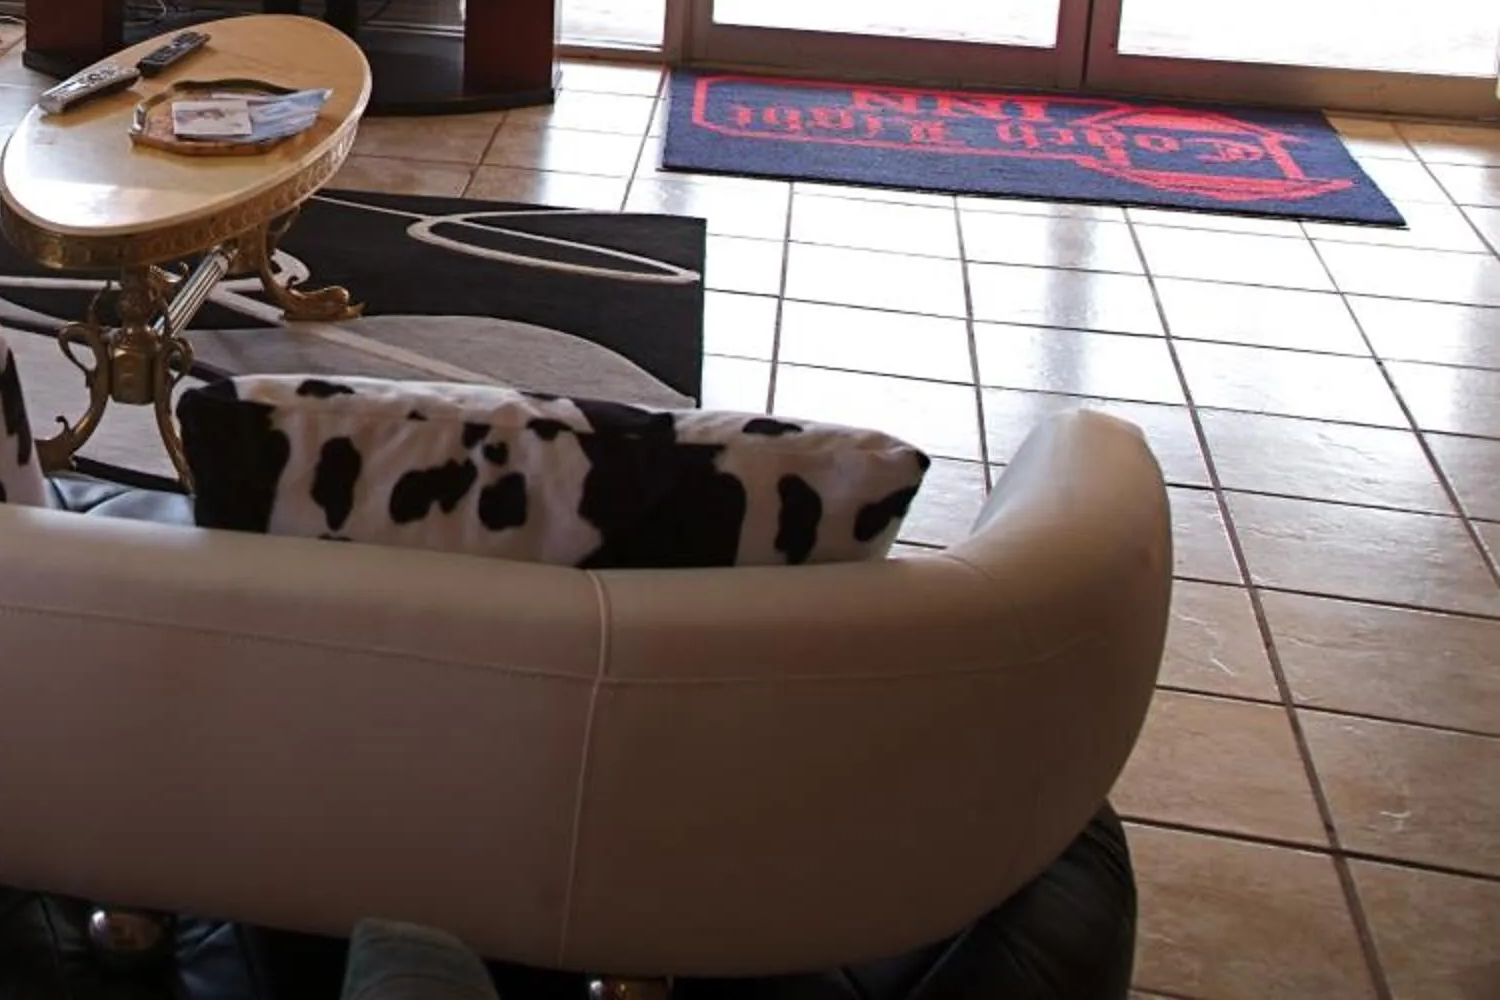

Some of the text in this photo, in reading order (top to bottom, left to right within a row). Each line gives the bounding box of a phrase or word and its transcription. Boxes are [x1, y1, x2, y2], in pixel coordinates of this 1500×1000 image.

[851, 89, 1055, 122] INN
[731, 105, 1264, 163] Coach Light
